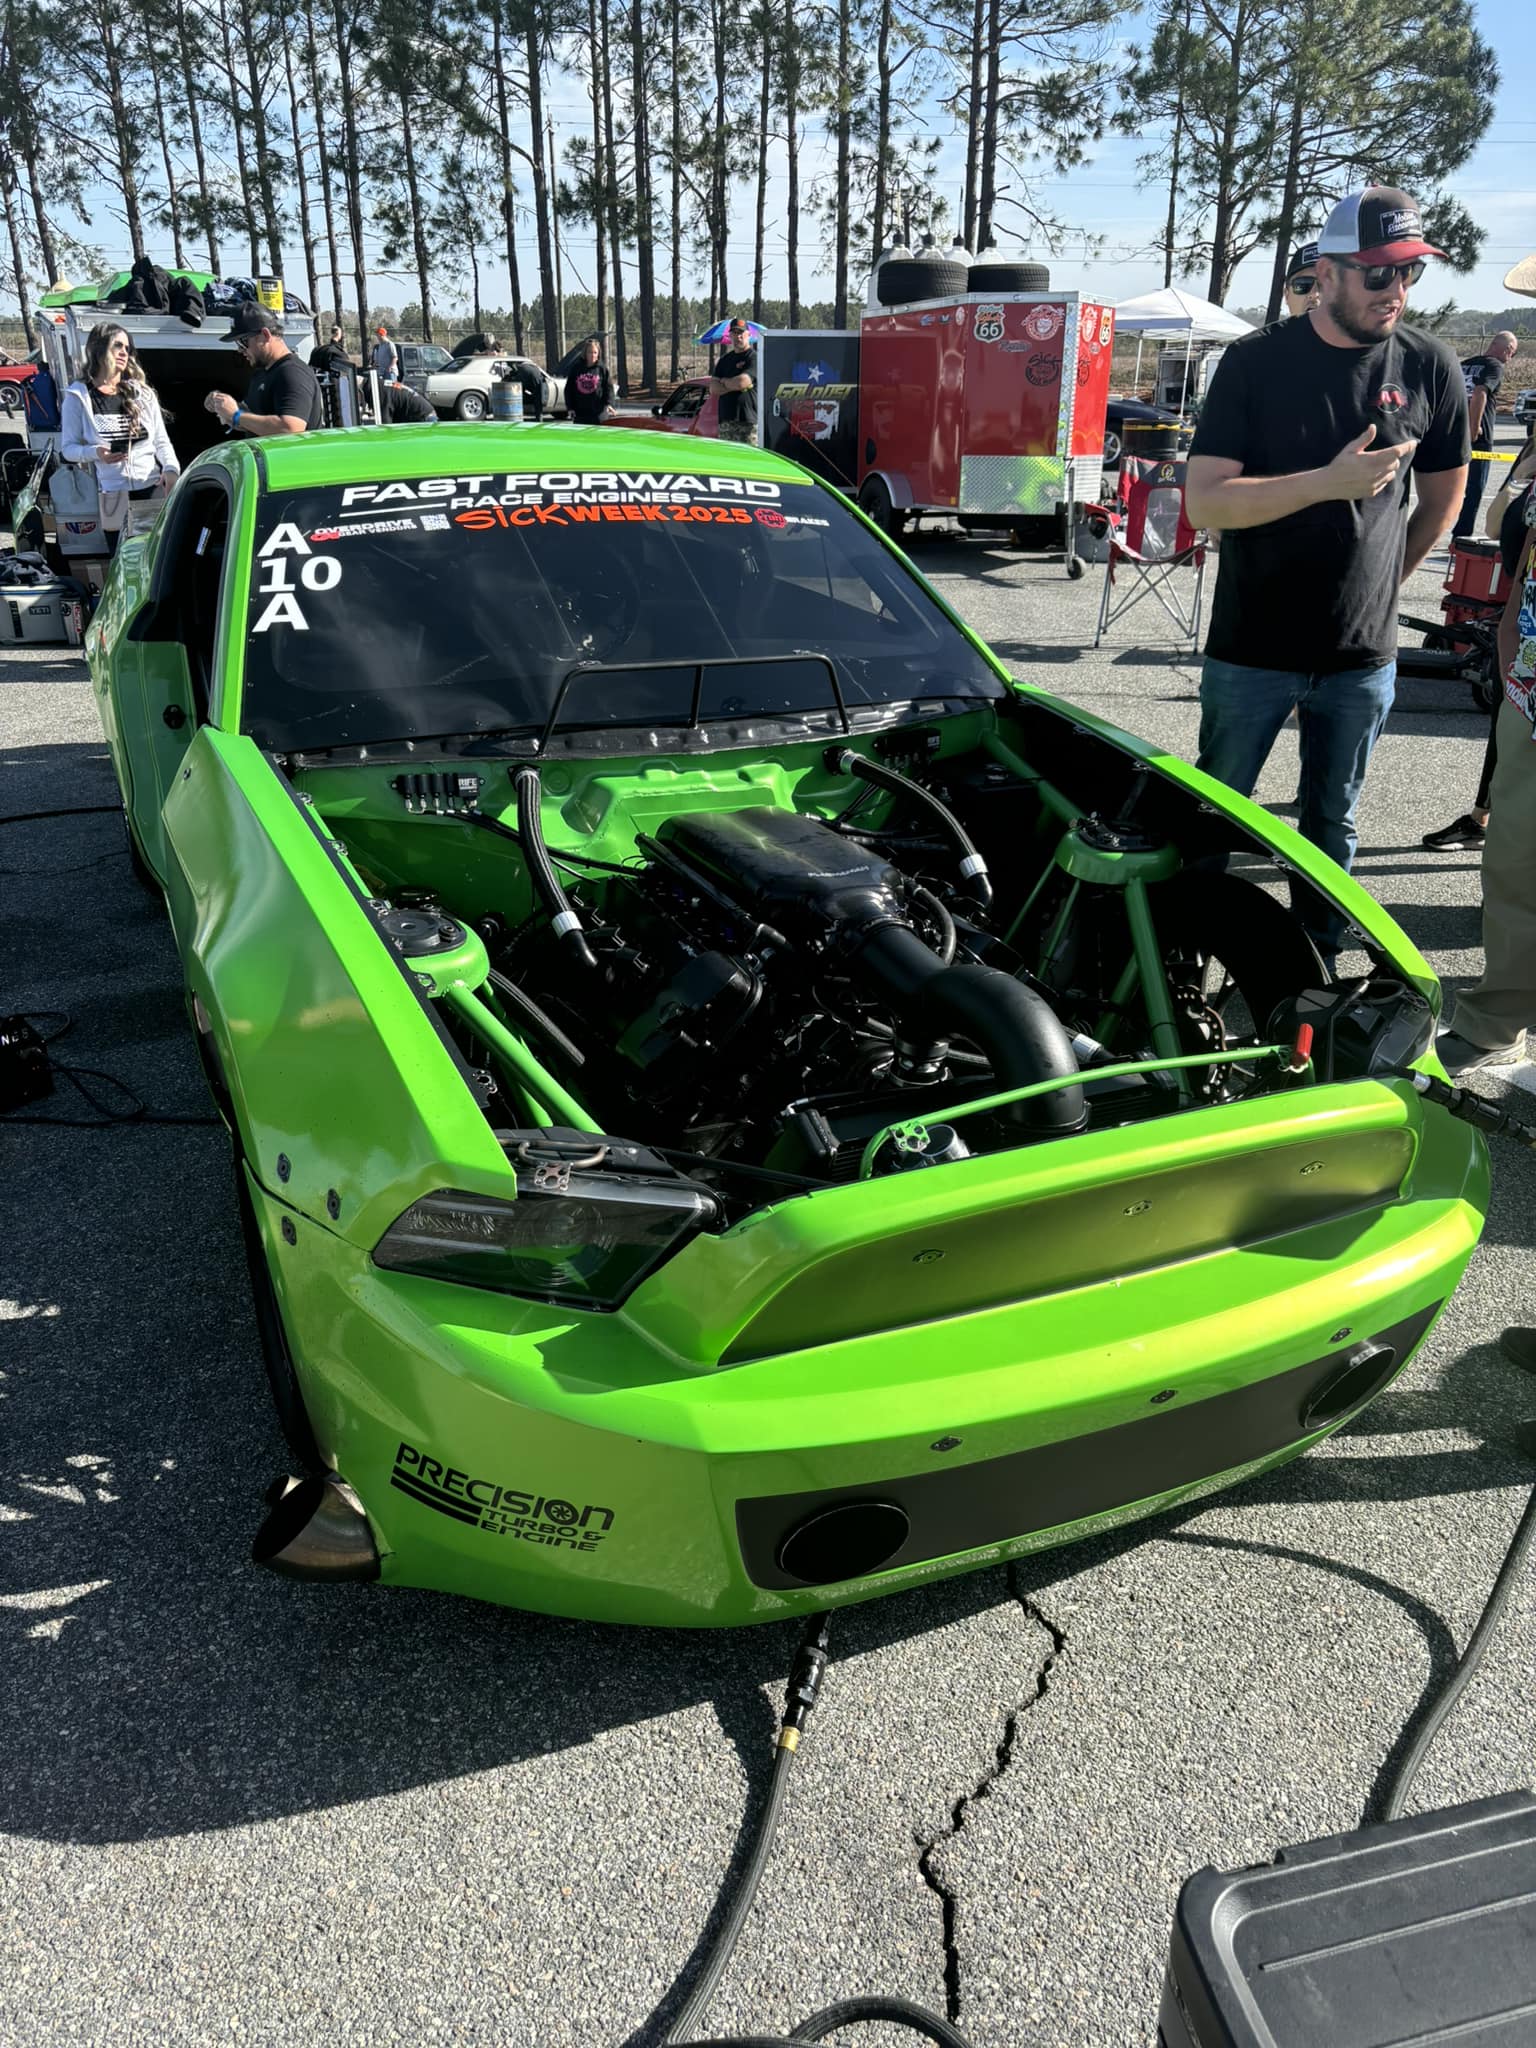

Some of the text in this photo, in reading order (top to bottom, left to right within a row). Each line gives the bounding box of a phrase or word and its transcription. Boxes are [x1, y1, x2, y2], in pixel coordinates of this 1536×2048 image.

[980, 322, 999, 337] 66
[341, 473, 781, 507] FAST FORWARD
[450, 491, 691, 510] RACE ENGINES
[563, 504, 669, 523] WEEK
[667, 505, 753, 524] 2025
[313, 518, 417, 535] OVERDRIVE
[257, 522, 313, 557] A
[259, 555, 343, 593] 10
[30, 606, 50, 614] YETI
[251, 592, 310, 633] A
[485, 1509, 579, 1538] TURBO
